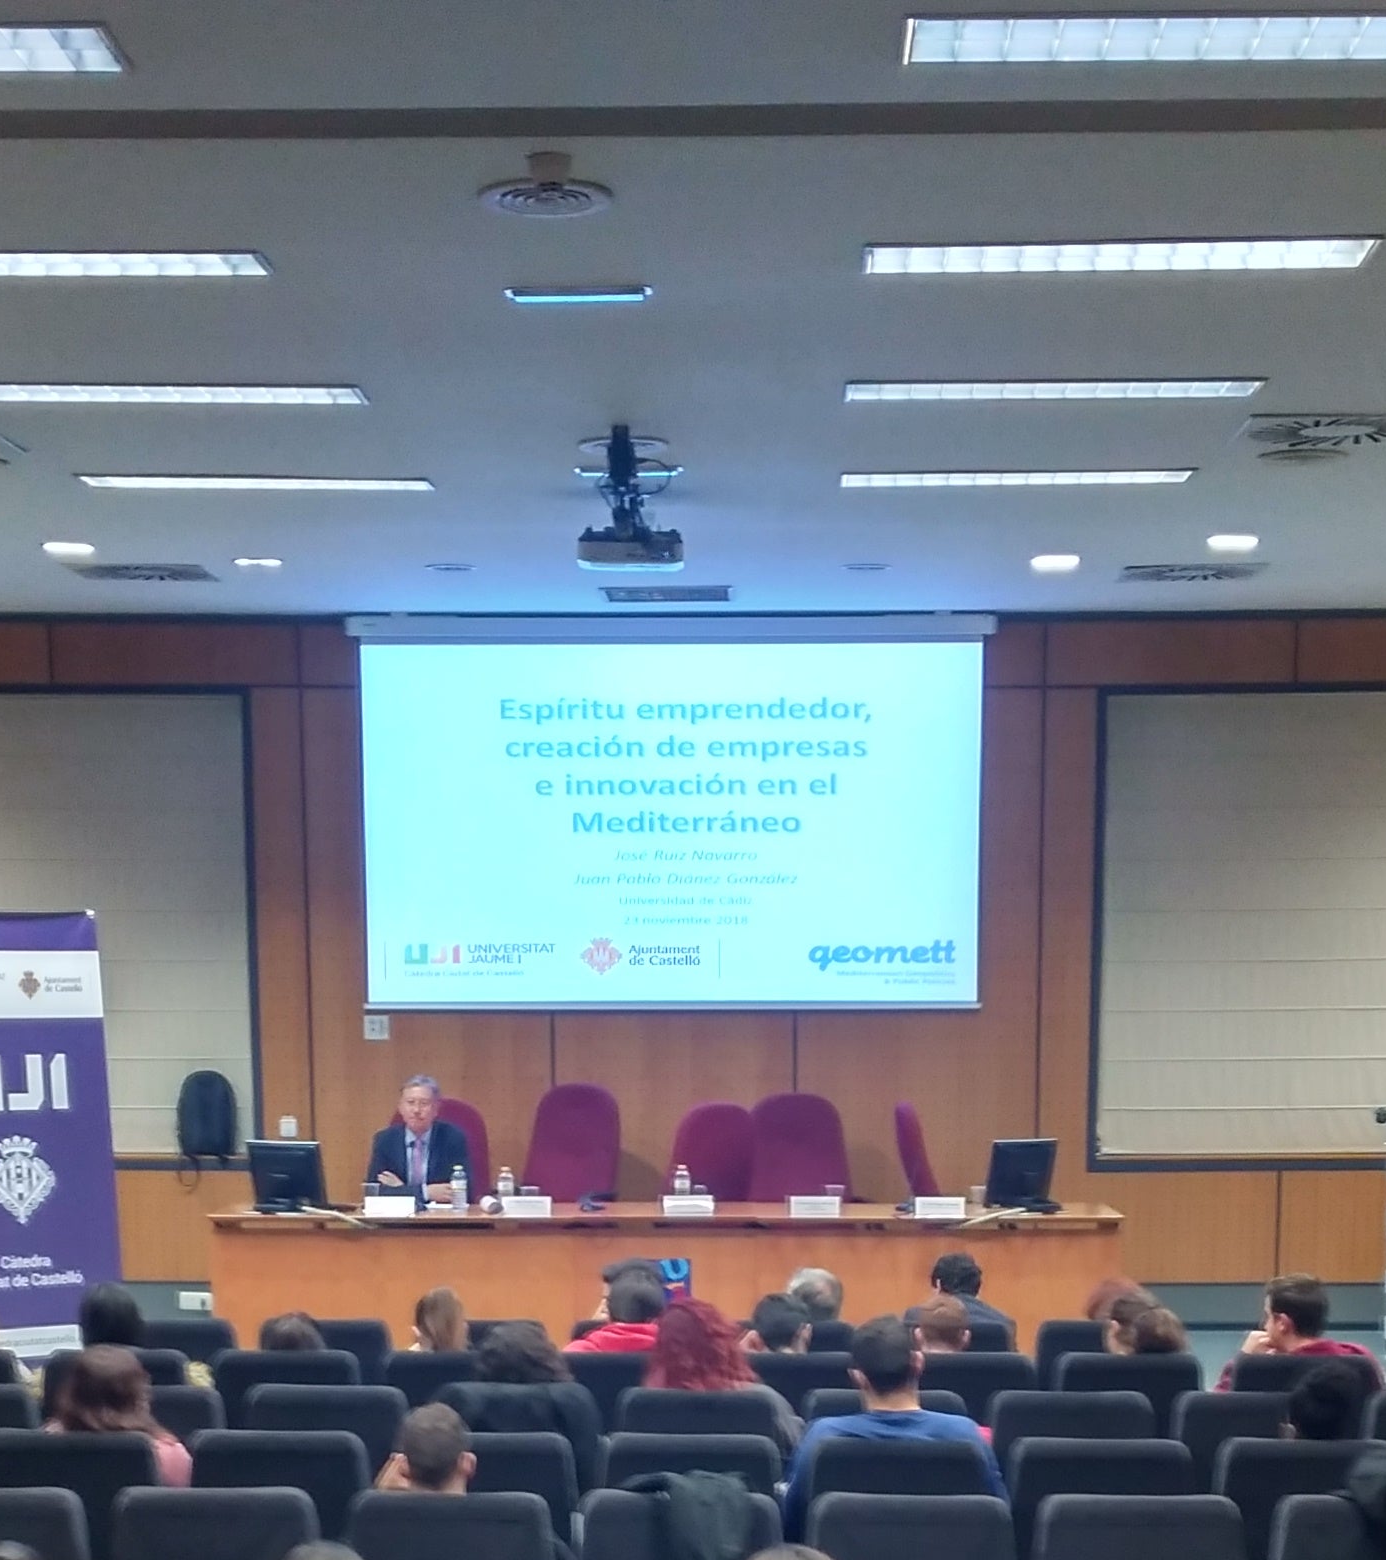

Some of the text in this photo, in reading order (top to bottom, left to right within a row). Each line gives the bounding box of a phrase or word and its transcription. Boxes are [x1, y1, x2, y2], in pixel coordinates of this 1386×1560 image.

[499, 697, 872, 725] Espíritu emprendedor,
[505, 735, 868, 762] creación de empresas
[535, 773, 838, 796] e innovación en el
[571, 810, 801, 834] Mediterráneo
[614, 849, 758, 862] José Ruiz Navarro
[574, 873, 611, 885] Juan
[616, 873, 661, 885] Pablo
[726, 873, 798, 885] González
[619, 896, 694, 906] Universidad
[700, 896, 715, 906] de
[404, 943, 461, 964] UJI
[467, 943, 556, 954] UNIVERSITAT
[629, 944, 700, 957] Ajuntament
[467, 954, 514, 964] JAUME
[629, 955, 701, 966] de Castelló
[808, 939, 957, 972] geomett
[12, 1273, 29, 1287] de
